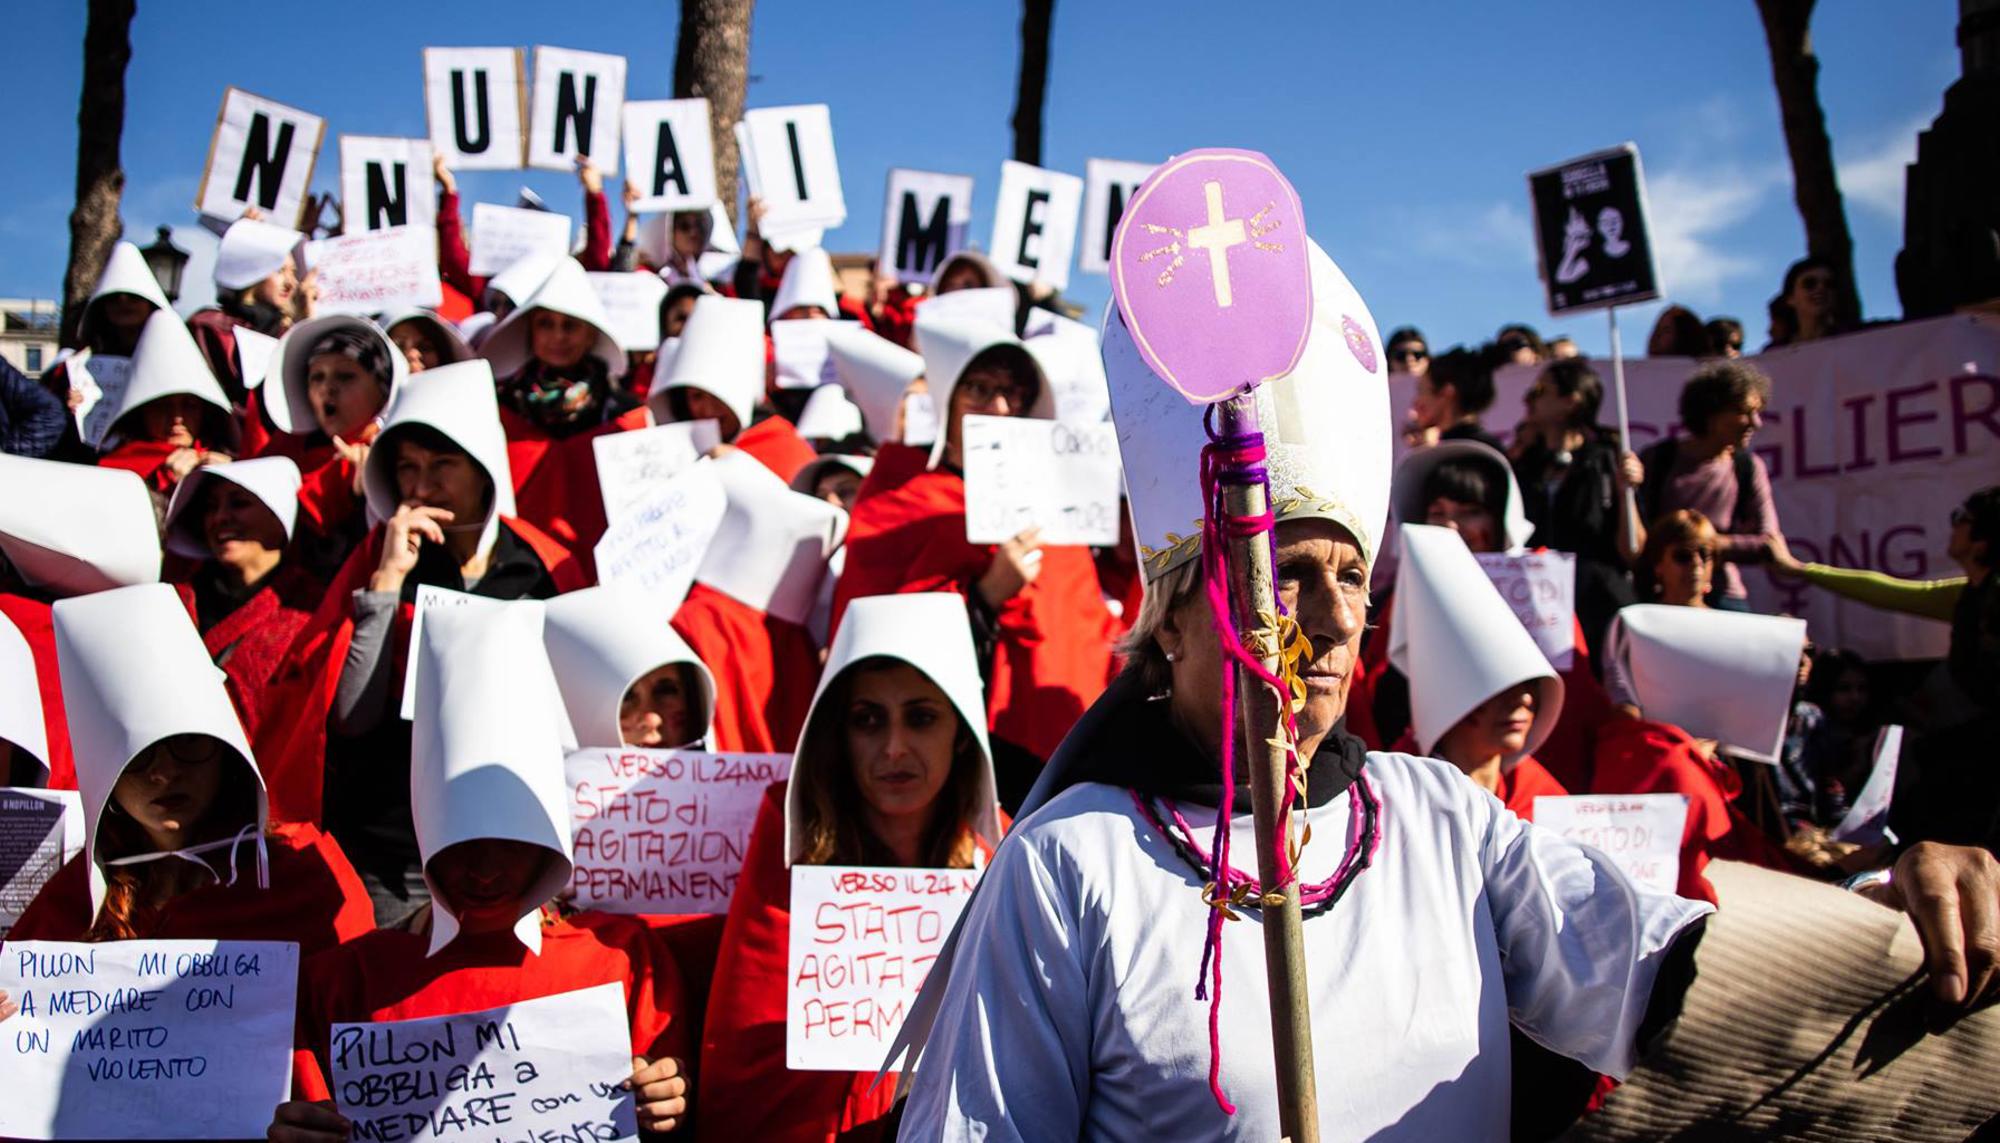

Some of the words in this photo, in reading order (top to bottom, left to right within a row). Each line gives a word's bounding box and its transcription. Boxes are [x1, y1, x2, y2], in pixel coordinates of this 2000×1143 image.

[451, 70, 490, 154] U
[554, 71, 596, 156] N
[233, 111, 295, 211] N
[653, 121, 689, 196] A
[786, 121, 808, 200] I
[367, 161, 407, 230] N
[896, 189, 951, 273] M
[1018, 189, 1050, 268] E
[606, 754, 685, 779] VERSO
[575, 781, 670, 824] STATO
[675, 793, 709, 826] di
[573, 827, 753, 867] AGITAZION
[831, 872, 897, 893] VERSO
[814, 901, 941, 944] STATO
[18, 949, 95, 978] PILLON
[138, 953, 166, 977] MI
[176, 952, 261, 977] OBBLIGA
[20, 990, 37, 1018] A
[49, 987, 165, 1016] MEDIARE
[186, 984, 234, 1011] CON
[16, 1028, 49, 1054] UN
[72, 1026, 168, 1051] MARITO
[332, 1022, 456, 1071] PILLON
[475, 1022, 520, 1051] MI
[87, 1055, 207, 1081] VIOLENTO
[343, 1062, 495, 1107] OBBLIGA
[351, 1092, 516, 1143] MEDIARE
[531, 1092, 582, 1113] con
